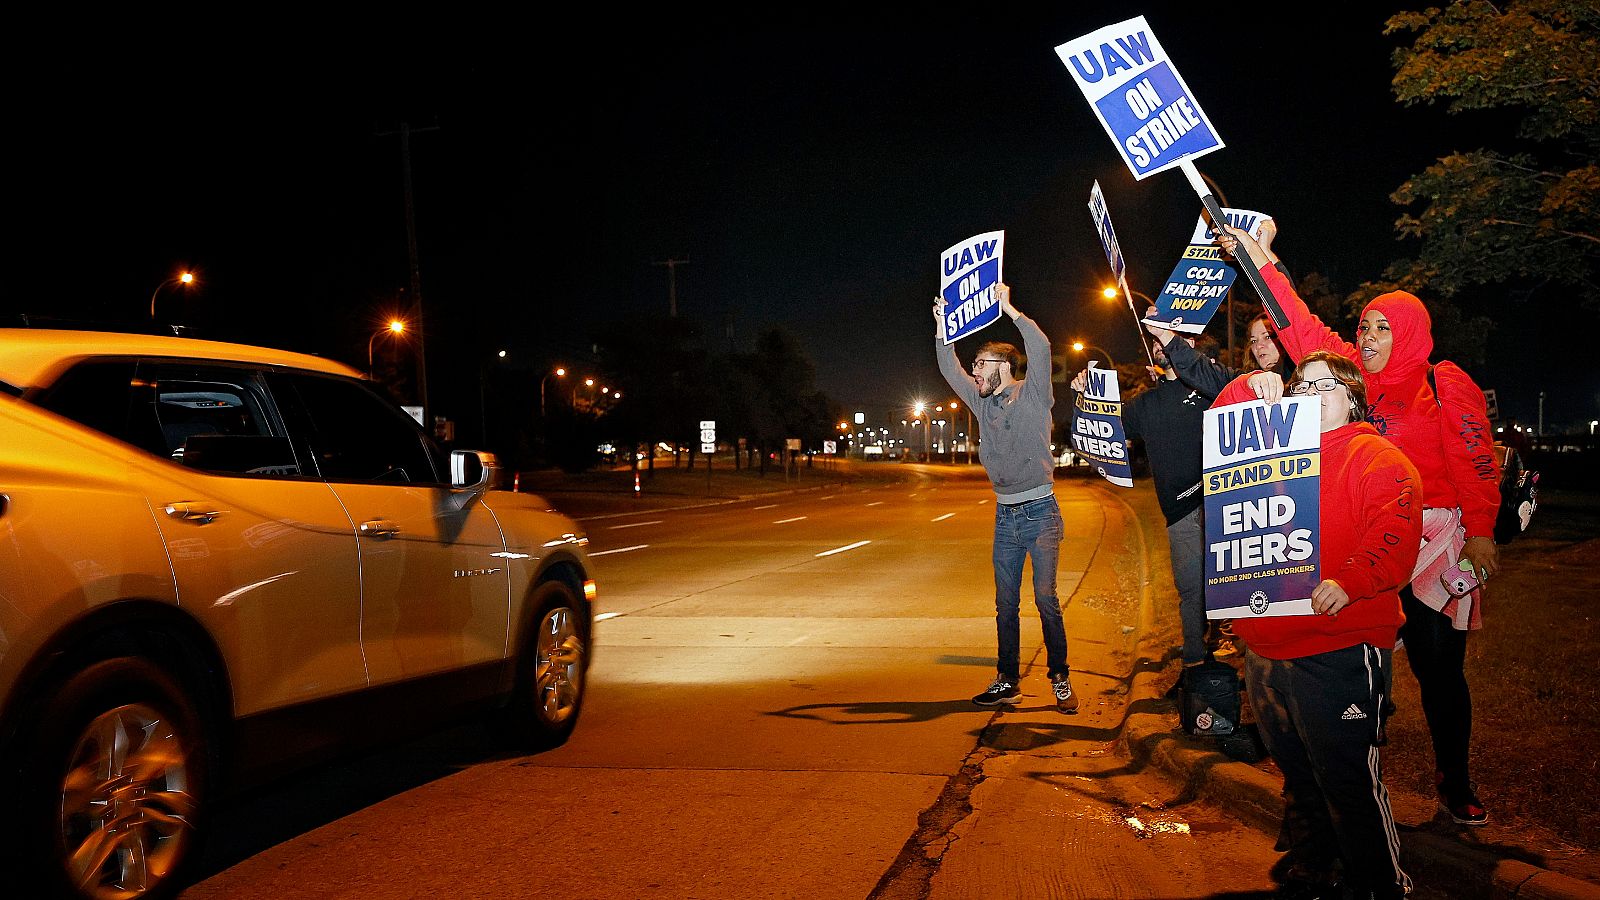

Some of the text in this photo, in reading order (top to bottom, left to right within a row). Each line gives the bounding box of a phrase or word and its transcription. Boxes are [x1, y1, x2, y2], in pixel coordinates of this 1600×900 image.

[1069, 31, 1155, 83] UAW
[1125, 77, 1164, 120] ON
[1125, 95, 1201, 168] STRIKE
[944, 239, 998, 276] UAW
[1187, 248, 1221, 259] STAN
[959, 269, 980, 301] ON
[1186, 266, 1225, 281] COLA
[1164, 282, 1229, 298] FAIR PAY
[1170, 297, 1208, 310] NOW
[947, 281, 998, 336] STRIKE
[1101, 403, 1118, 413] UP
[703, 432, 712, 440] 12
[1076, 416, 1114, 438] END
[1218, 402, 1298, 456] UAW
[1072, 433, 1125, 459] TIERS
[1209, 458, 1312, 491] STAND UP
[1222, 494, 1296, 535] END
[1209, 528, 1314, 572] TIERS
[1208, 564, 1316, 586] NO MORE 2ND CLASS WORKERS
[1341, 712, 1368, 720] adidas
